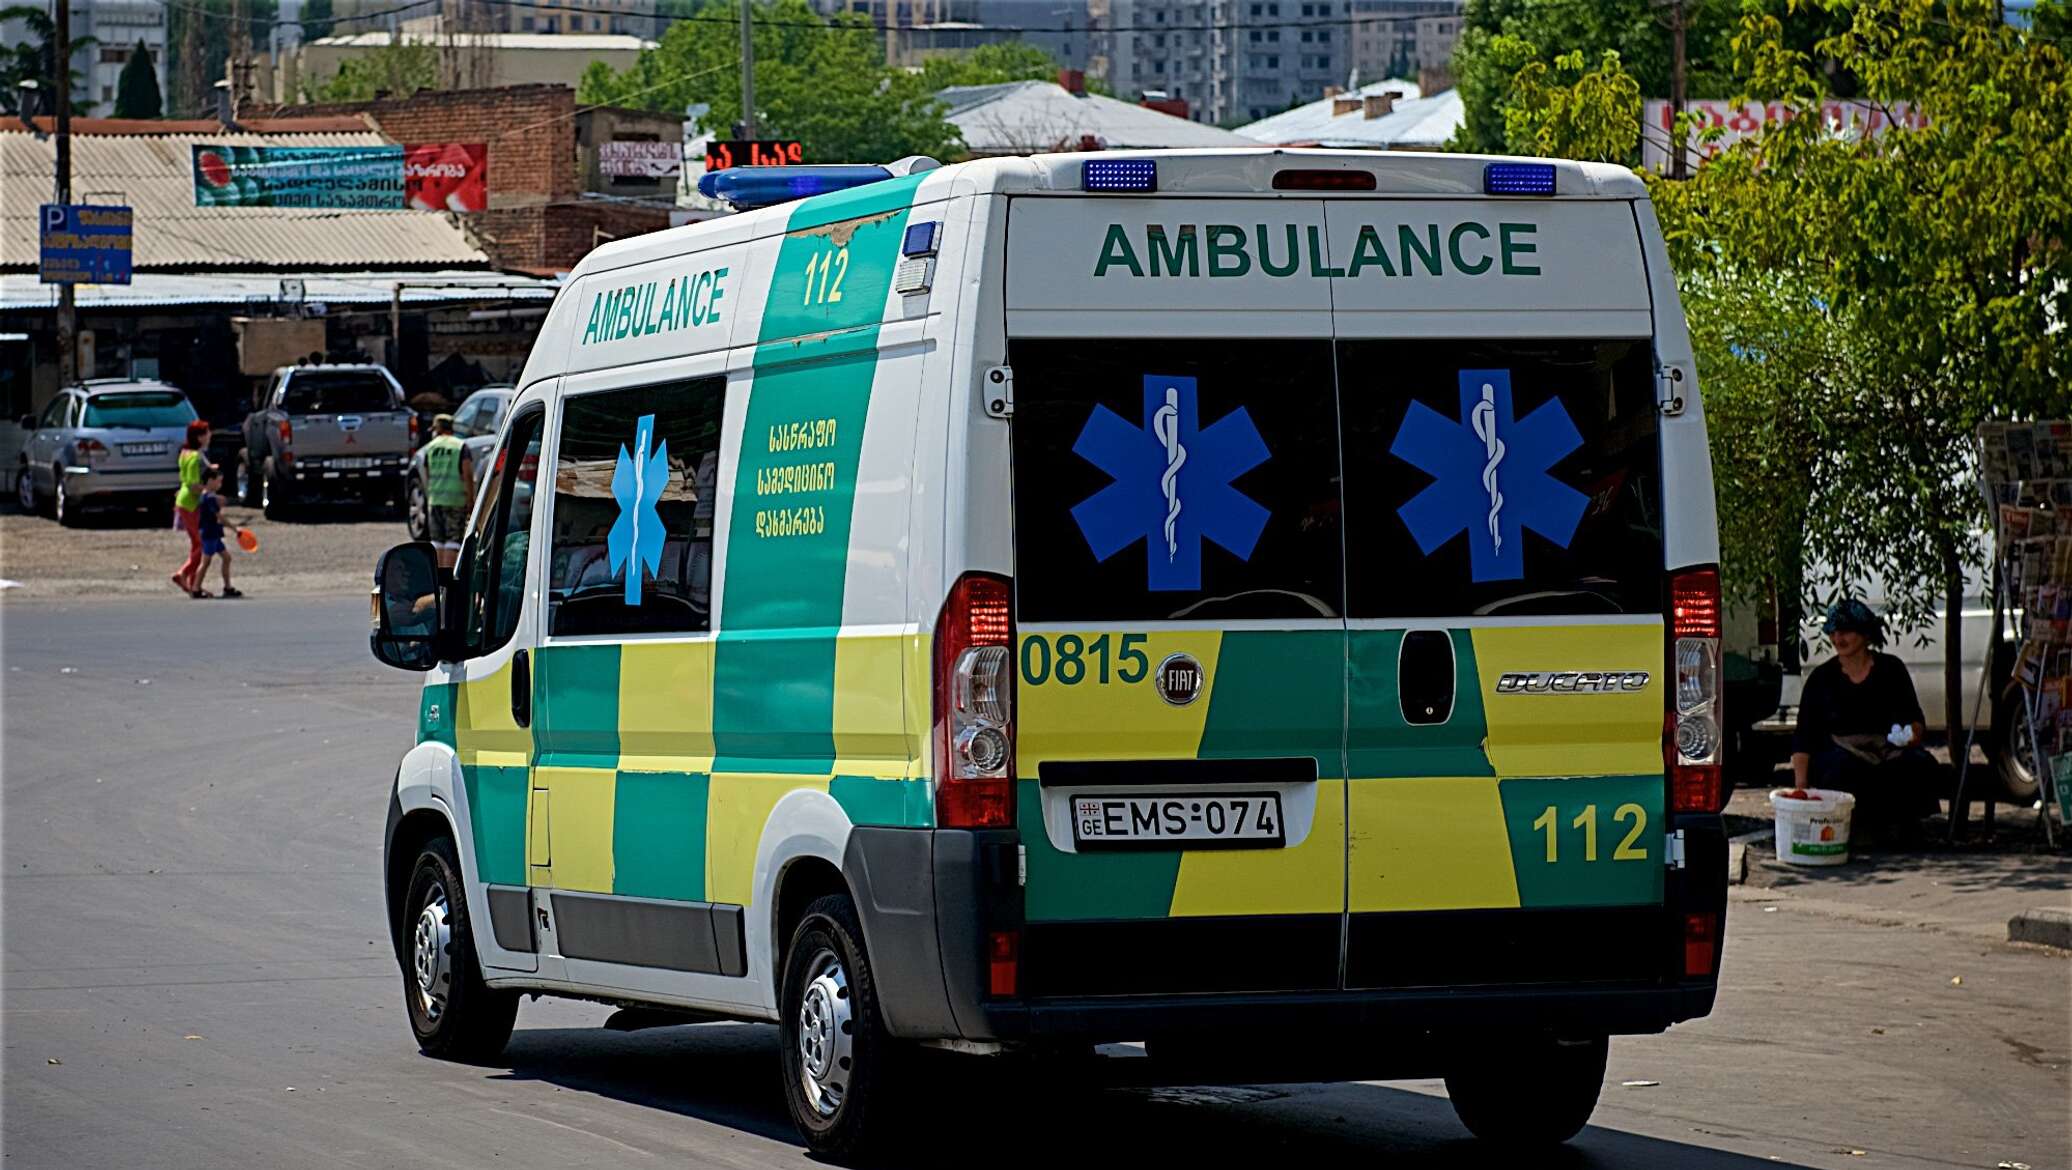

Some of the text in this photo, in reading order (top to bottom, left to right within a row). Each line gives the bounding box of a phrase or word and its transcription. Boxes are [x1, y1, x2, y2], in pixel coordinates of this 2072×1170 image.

[398, 163, 466, 178] ბაზრობა
[317, 193, 405, 208] საზამთრო
[47, 207, 65, 231] P
[1094, 221, 1541, 278] AMBULANCE
[803, 248, 849, 306] 112
[582, 267, 729, 345] AMBULANCE
[768, 418, 837, 453] სასწრაფო
[757, 462, 835, 496] სამედიცინო
[755, 505, 825, 538] დახმარება
[1021, 634, 1149, 686] 0815
[1168, 670, 1195, 692] FIAT
[1496, 671, 1651, 694] DUCATO
[1081, 818, 1103, 836] GE
[1533, 803, 1648, 863] 112
